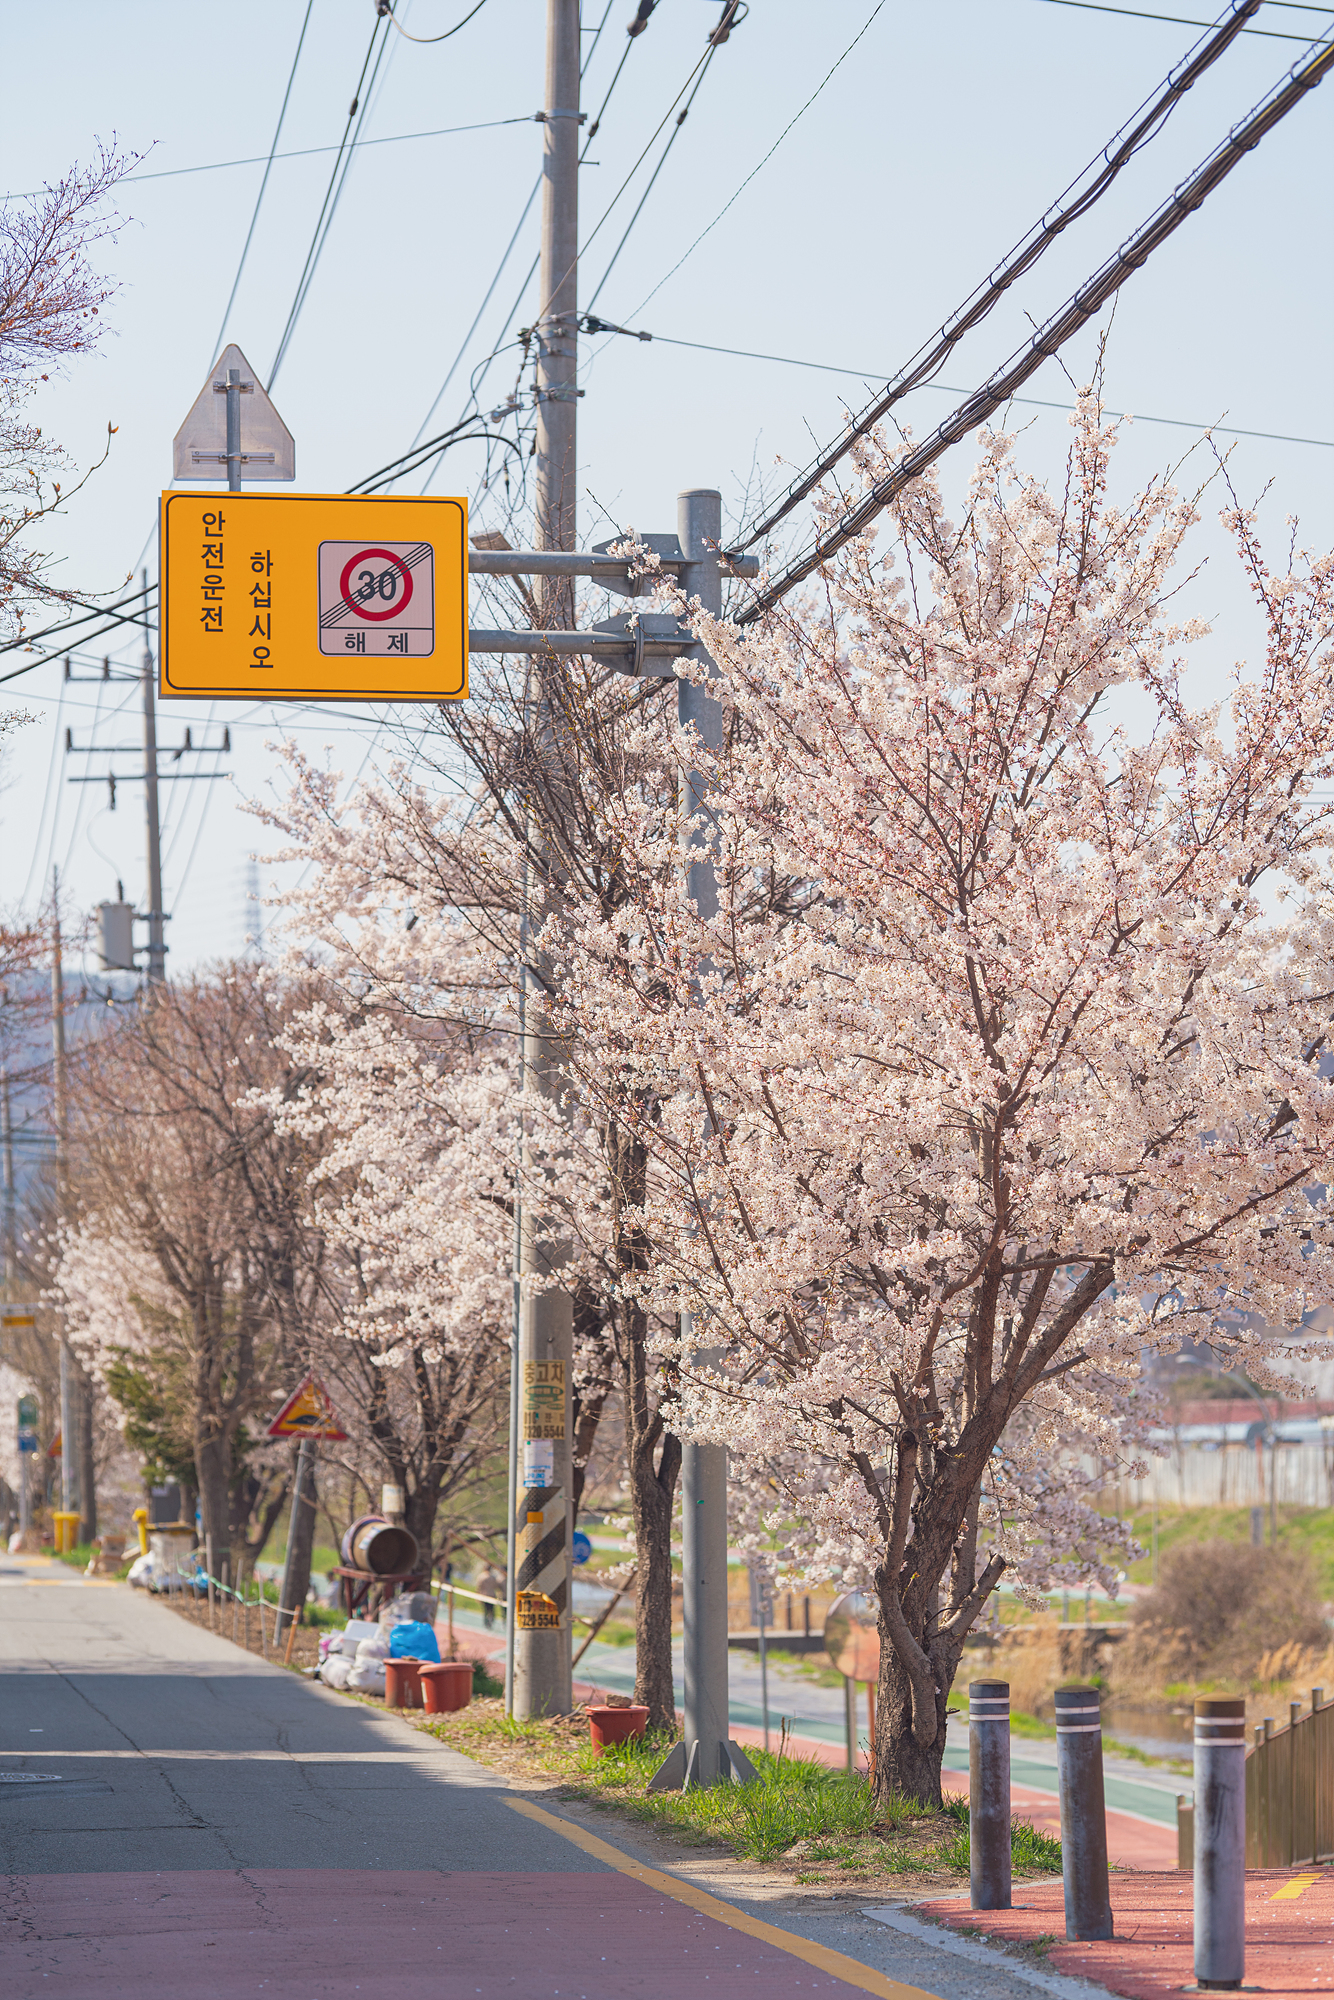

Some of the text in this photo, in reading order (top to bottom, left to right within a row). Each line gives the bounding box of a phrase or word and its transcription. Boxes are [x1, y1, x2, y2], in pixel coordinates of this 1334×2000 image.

[200, 510, 226, 633] 안전운전
[357, 570, 397, 601] 30
[248, 550, 274, 669] 하십시오
[525, 1363, 564, 1384] 중고차
